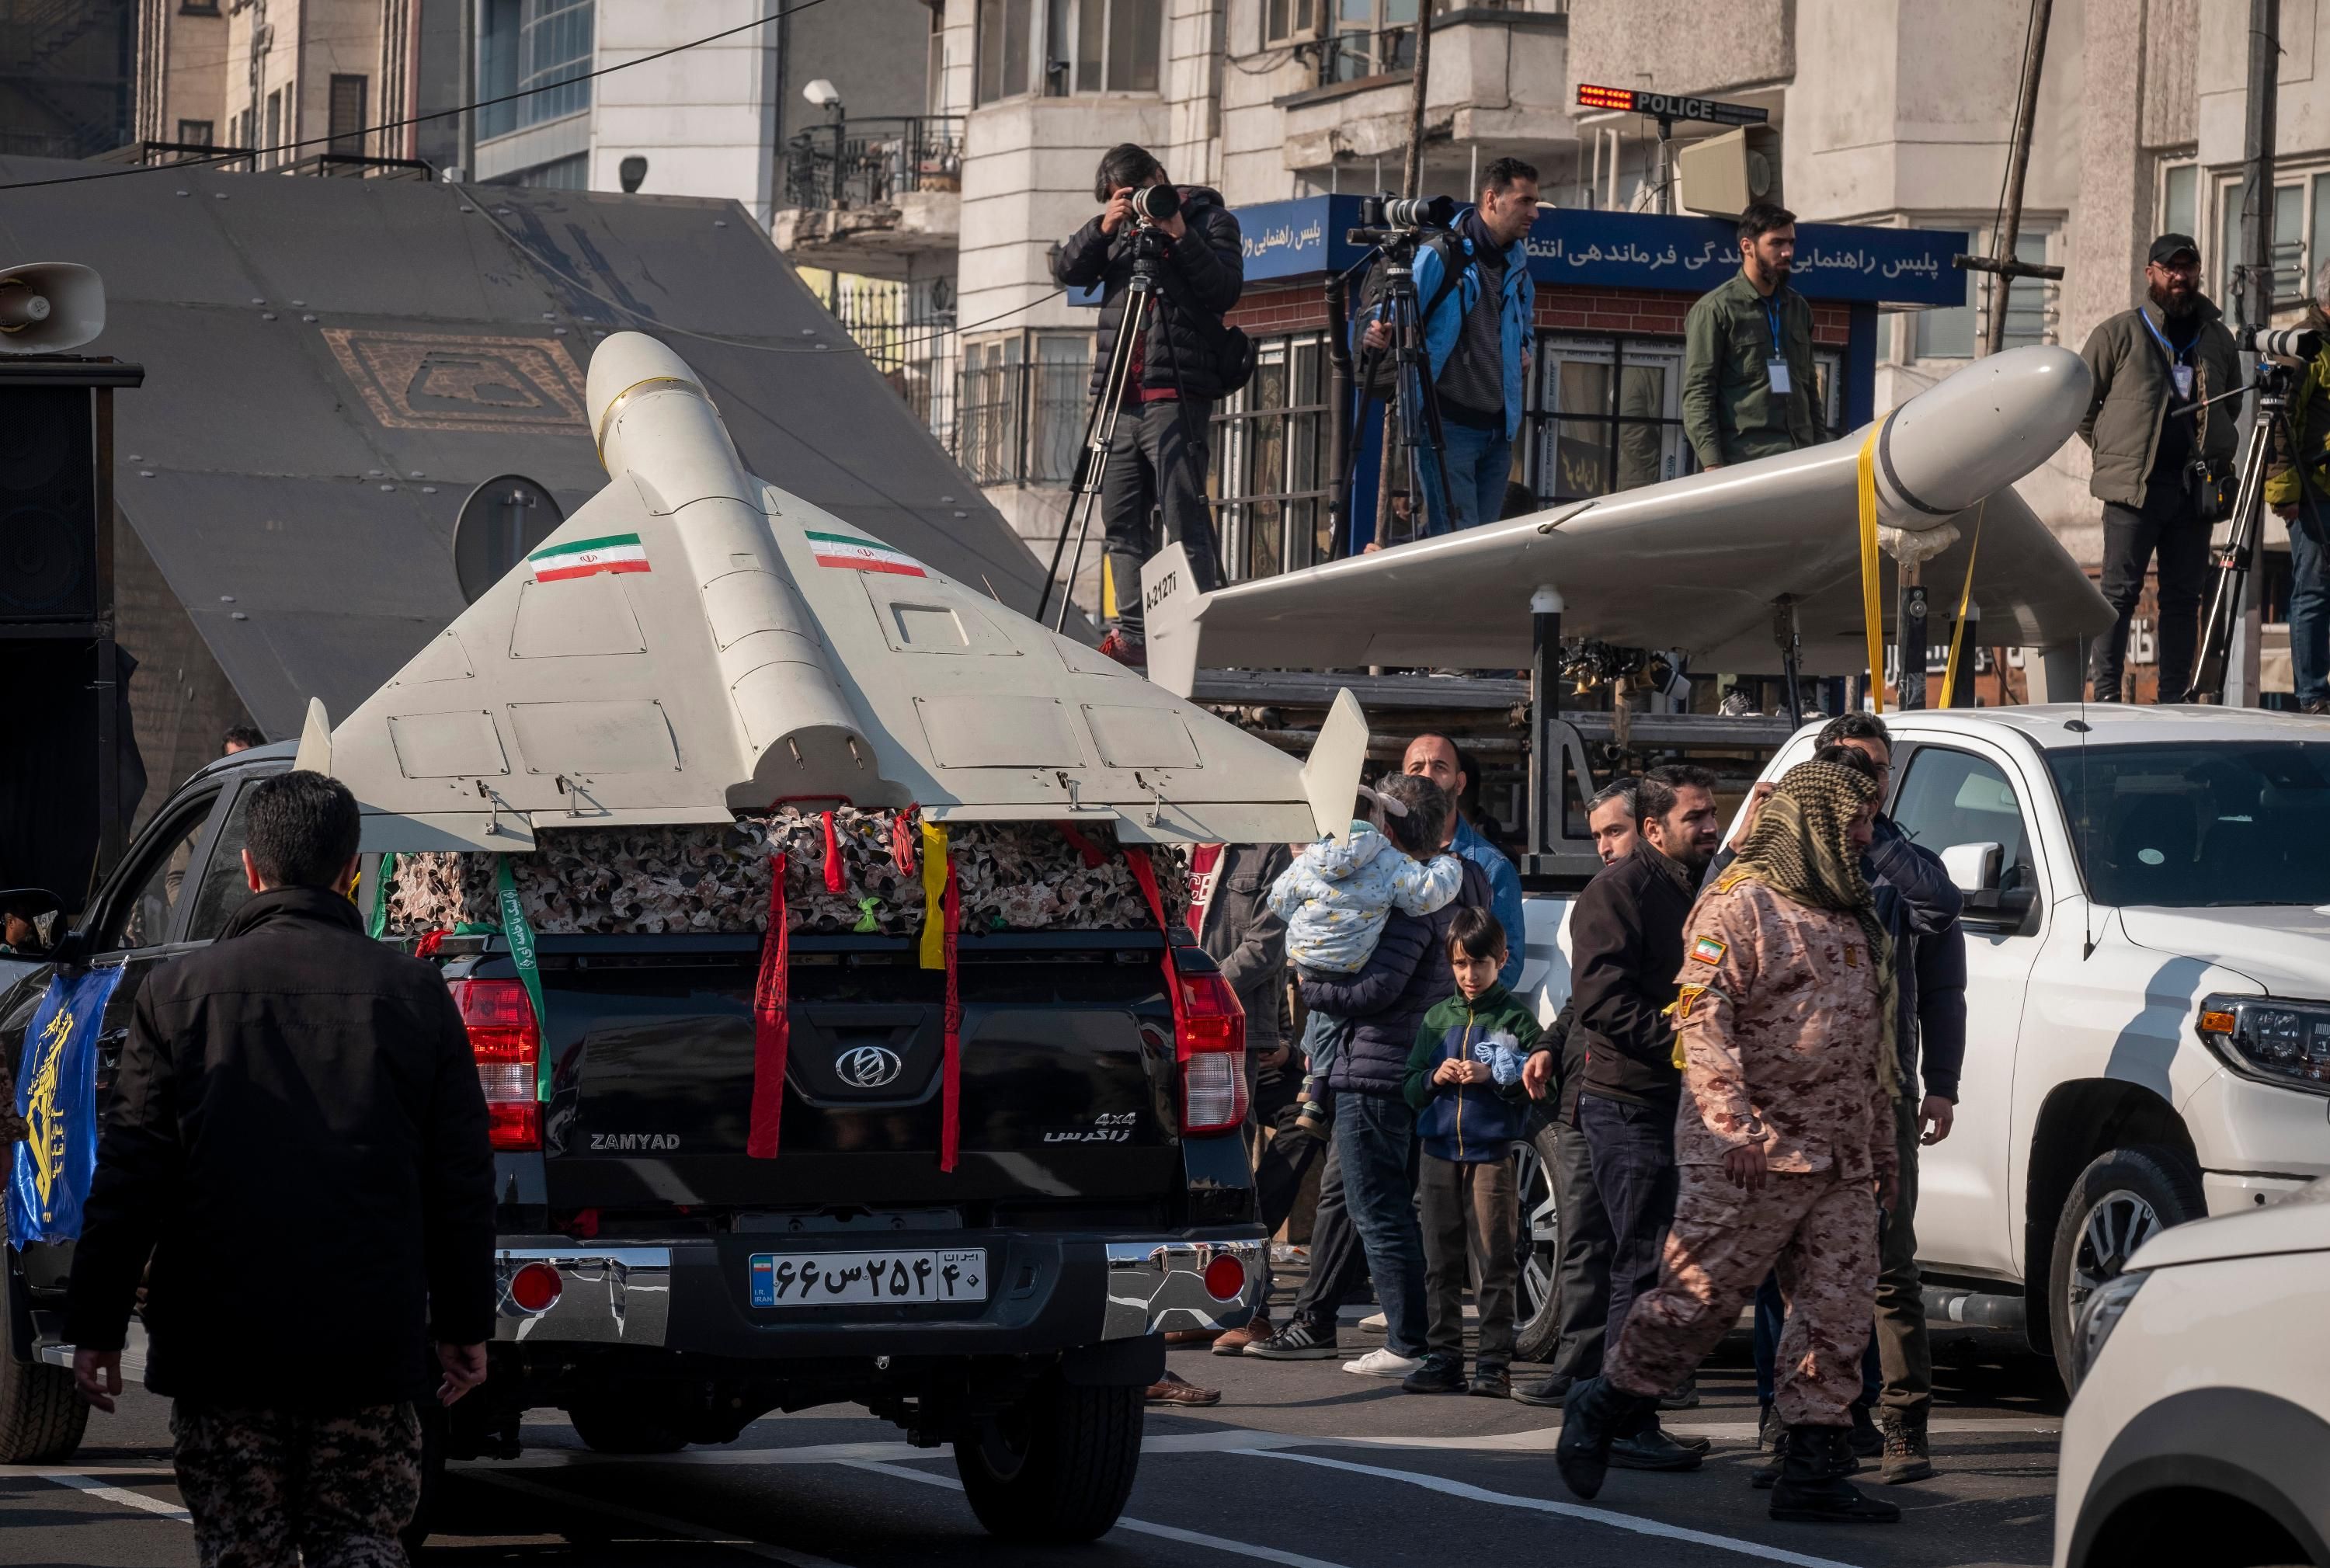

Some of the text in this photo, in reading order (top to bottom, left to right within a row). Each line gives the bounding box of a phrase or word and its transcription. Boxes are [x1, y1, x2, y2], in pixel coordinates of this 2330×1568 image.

[1637, 92, 1713, 120] POLICE
[1254, 224, 1294, 257] راهنمایی
[1295, 218, 1320, 251] پلیس
[1524, 237, 1563, 259] انتظ
[1568, 243, 1678, 270] فرماندهی
[1789, 248, 1876, 274] راهنمایی
[1882, 252, 1939, 280] پلیس
[1094, 1111, 1136, 1126] 4x4
[590, 1133, 680, 1149] ZAMYAD
[1043, 1128, 1130, 1142] زاگرس
[944, 1253, 979, 1262] ایران
